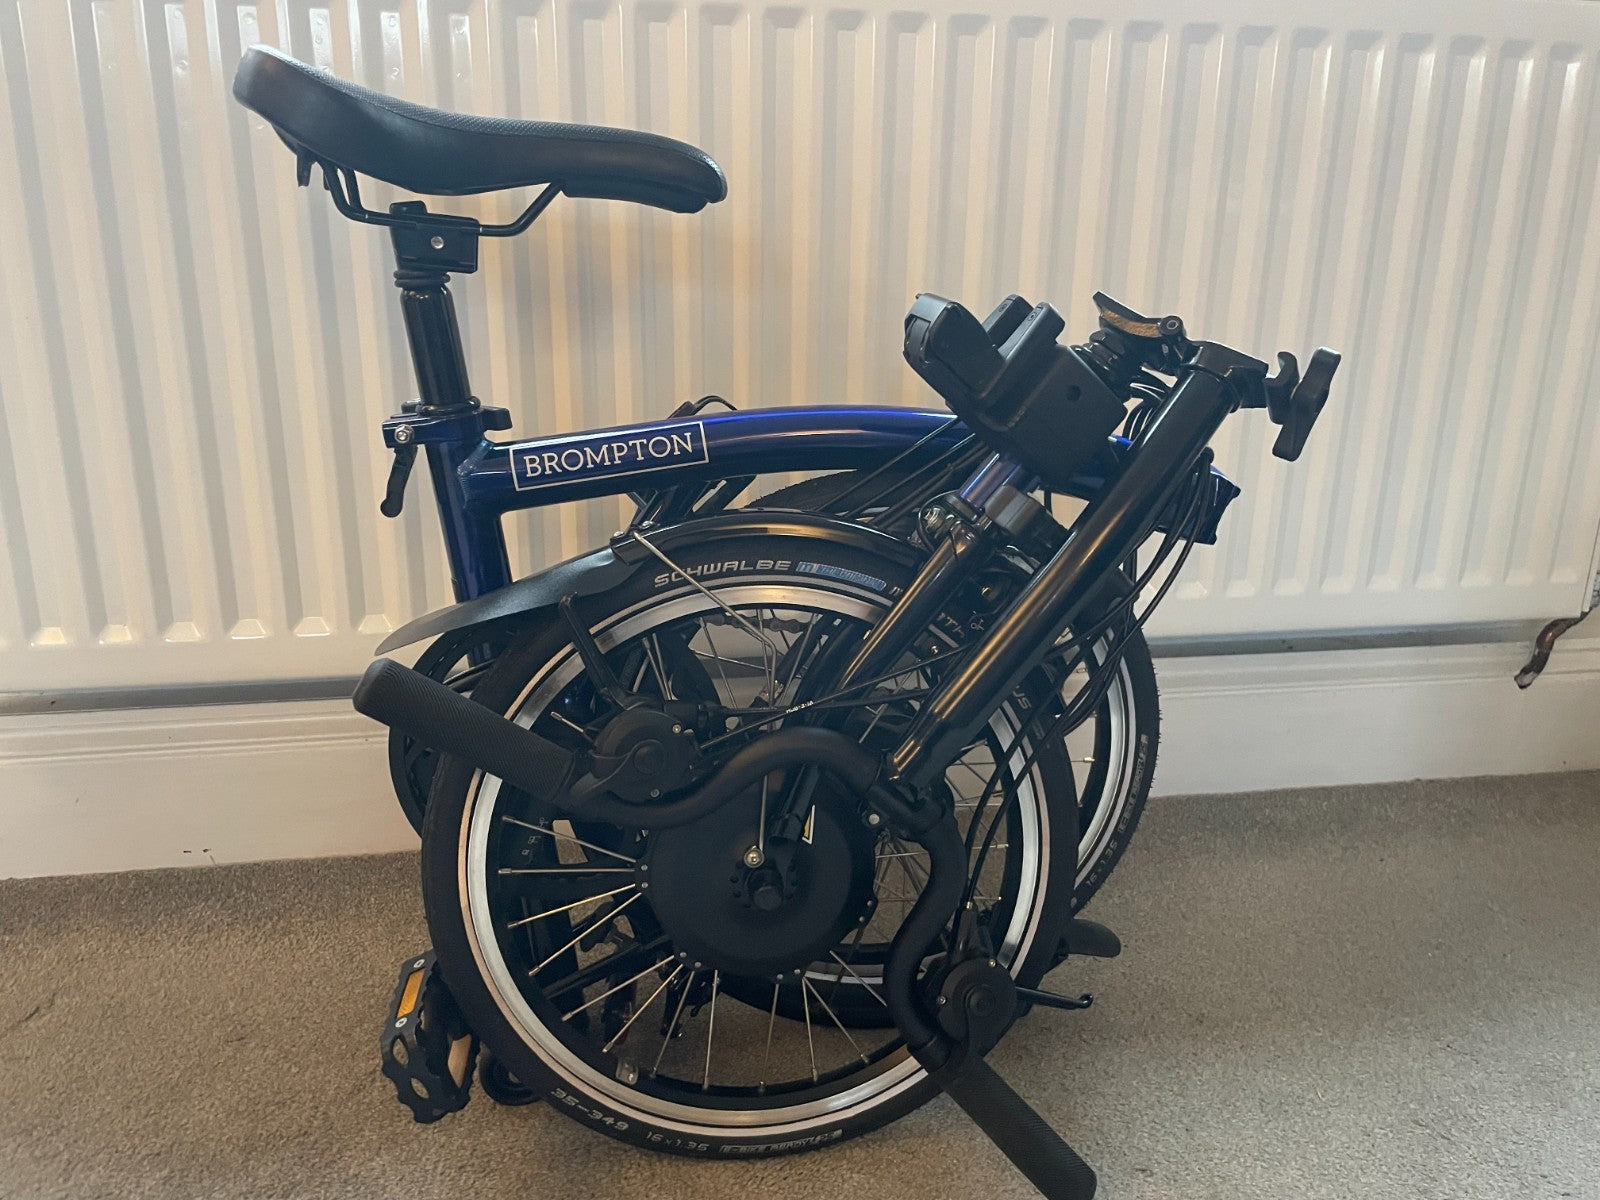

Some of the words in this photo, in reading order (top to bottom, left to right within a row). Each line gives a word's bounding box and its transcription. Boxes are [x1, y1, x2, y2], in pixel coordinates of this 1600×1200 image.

[523, 431, 693, 478] BROMPTON
[653, 559, 793, 589] SCHWALBE
[550, 1087, 630, 1132] 35-349
